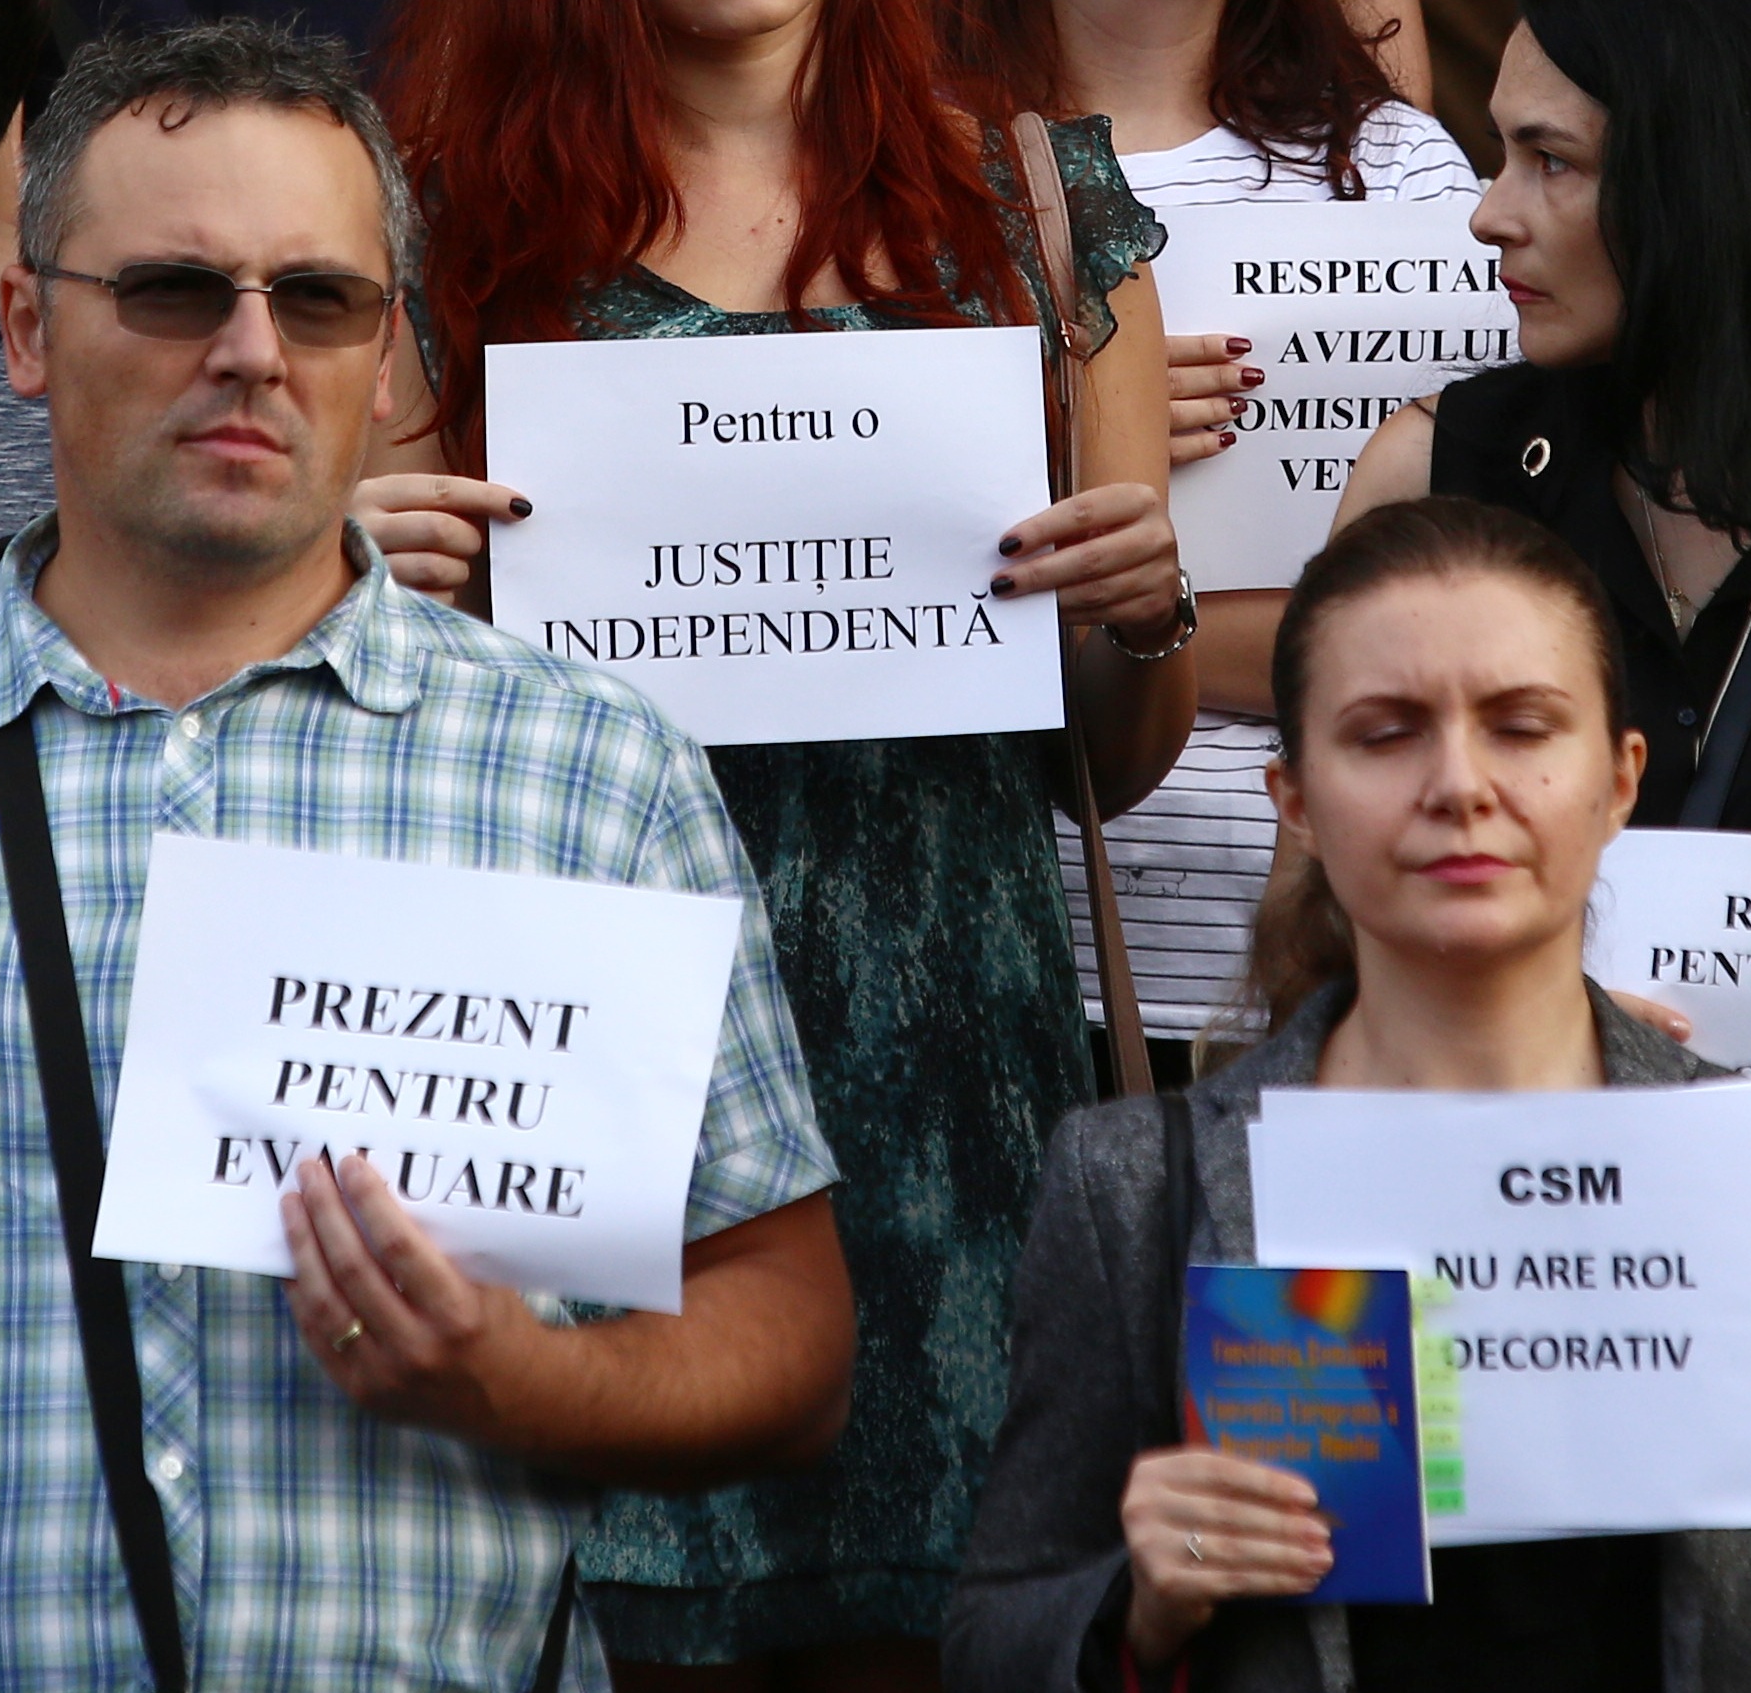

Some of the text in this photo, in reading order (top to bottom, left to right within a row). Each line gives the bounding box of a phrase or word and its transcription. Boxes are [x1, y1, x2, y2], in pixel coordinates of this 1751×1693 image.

[1278, 328, 1511, 363] AVIZULUI
[679, 402, 878, 445] Pentru o
[1205, 396, 1410, 431] OMISIE
[645, 537, 894, 595] JUSTIȚIE
[540, 592, 1004, 661] INDEPENDENTĂ
[268, 975, 589, 1051] PREZENT
[273, 1059, 550, 1129] PENTRU
[1498, 1163, 1622, 1205] CSM
[1436, 1253, 1696, 1290] NU ARE ROL
[1448, 1334, 1692, 1373] DECORATIV
